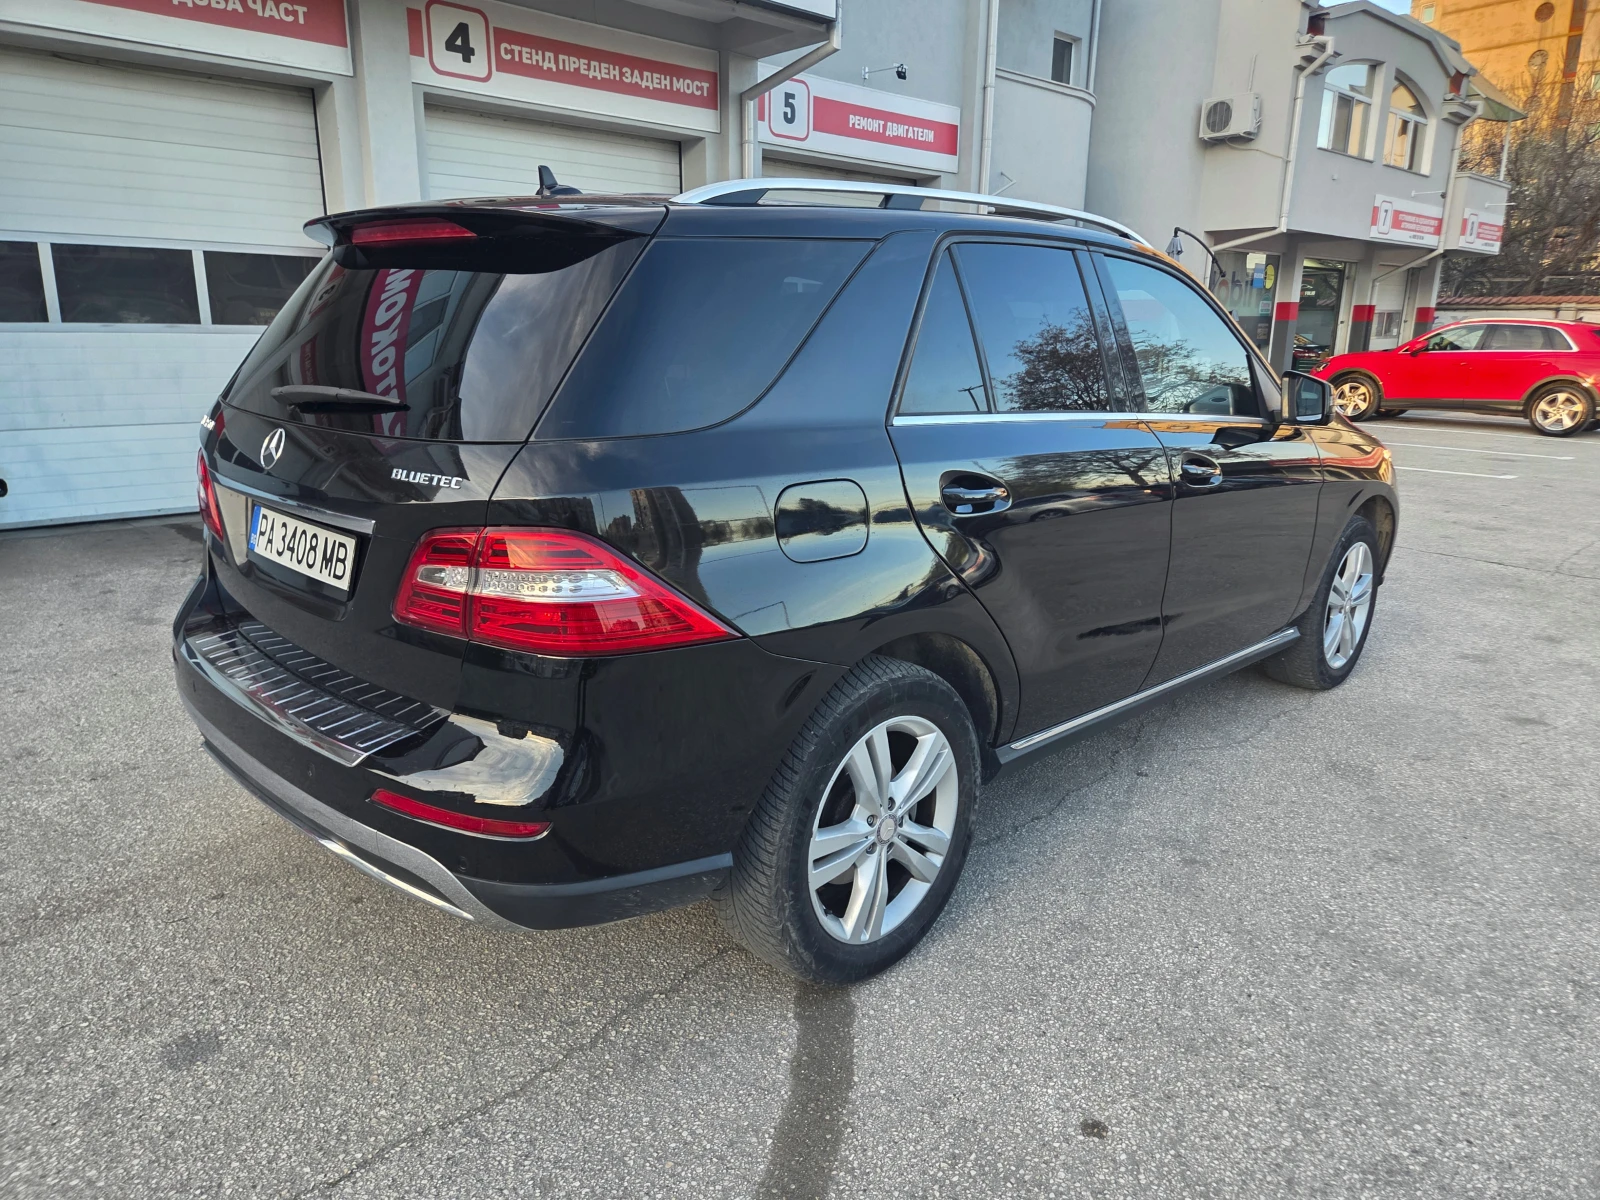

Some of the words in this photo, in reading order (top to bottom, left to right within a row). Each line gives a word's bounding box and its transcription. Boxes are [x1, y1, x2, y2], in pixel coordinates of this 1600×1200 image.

[247, 0, 308, 24] ЧАСТ
[444, 22, 476, 64] 4
[500, 42, 556, 72] СТЕНД
[558, 54, 620, 81] ПРЕДЕН
[621, 66, 671, 90] ЗАДЕН
[672, 76, 710, 97] МОСТ
[782, 91, 796, 125] 5
[849, 114, 885, 134] РЕМОНТ
[885, 121, 934, 143] ДВИГАТЕЛИ
[1382, 208, 1389, 227] 7
[391, 467, 463, 489] BLUETEC
[257, 513, 275, 554] PA
[276, 521, 319, 569] 3408
[320, 536, 348, 581] MB
